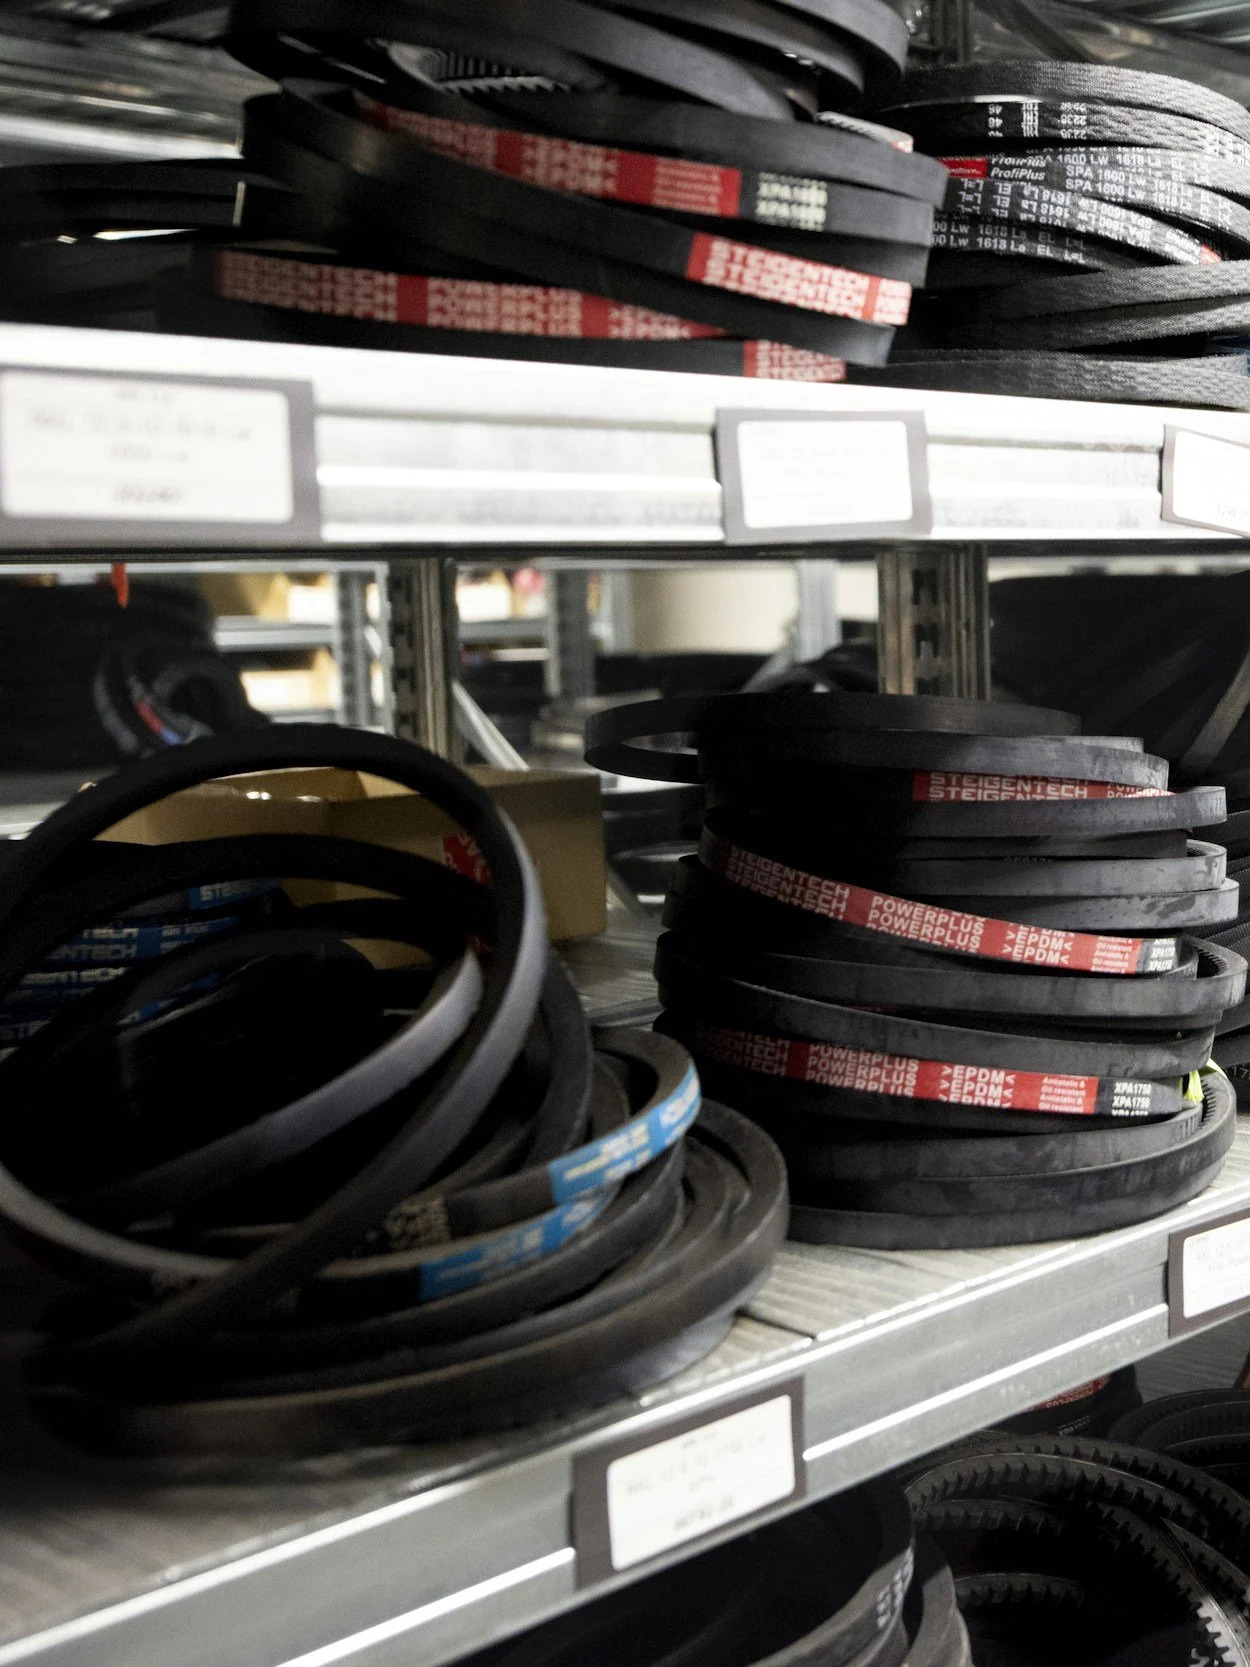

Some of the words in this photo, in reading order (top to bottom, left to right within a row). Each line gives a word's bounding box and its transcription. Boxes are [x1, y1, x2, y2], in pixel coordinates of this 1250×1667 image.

[990, 167, 1046, 181] ProfiPlus
[1065, 165, 1093, 178] SPA
[1065, 179, 1092, 192] SPA
[950, 235, 968, 247] Lw
[977, 236, 1007, 249] 1618
[930, 772, 1088, 799] STEIGENTECH
[731, 845, 850, 900] STEIGENTECH
[872, 895, 984, 935] POWERPLUS
[728, 858, 847, 913] STEIGENTECH
[869, 908, 981, 948] POWERPLUS
[1006, 929, 1073, 951] >EPDM<
[1002, 943, 1069, 965] >EPDM<
[807, 1055, 917, 1086] POWERPLUS
[941, 1063, 1016, 1085] >EPDM<
[938, 1078, 1013, 1099] >EPDM<
